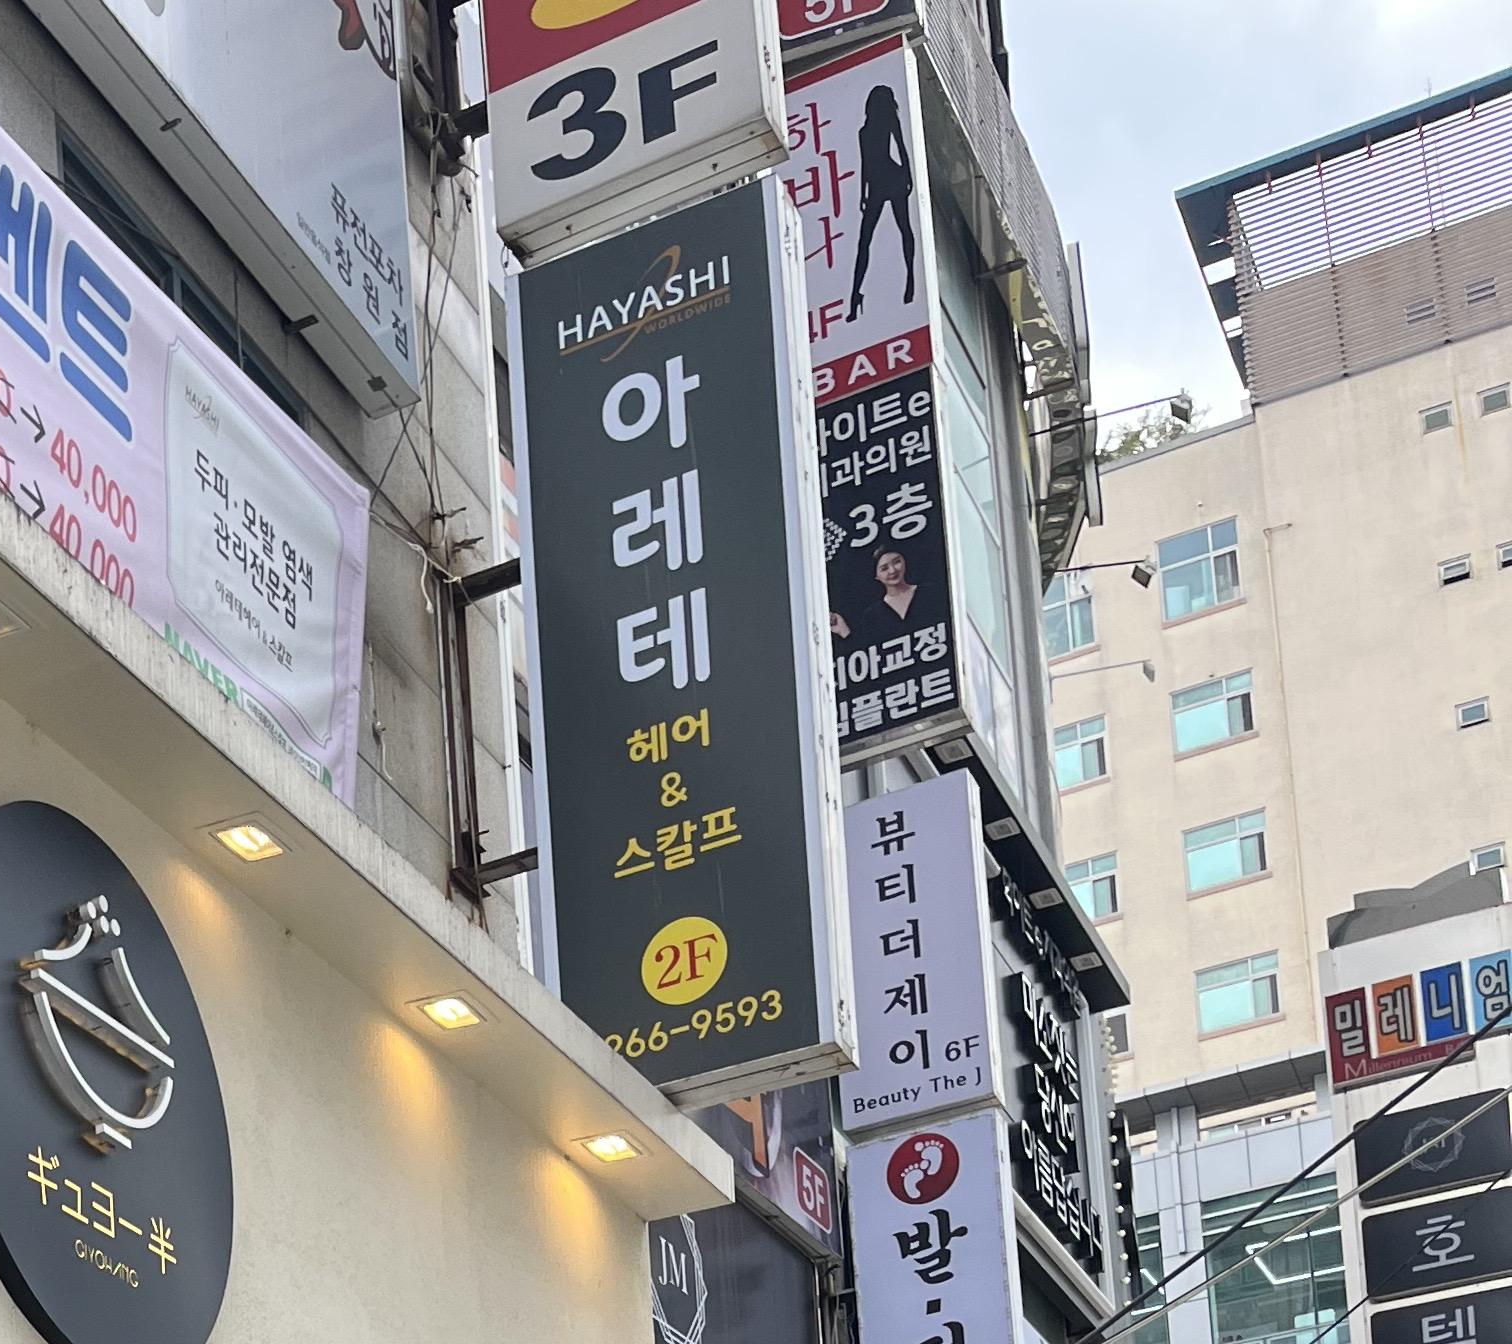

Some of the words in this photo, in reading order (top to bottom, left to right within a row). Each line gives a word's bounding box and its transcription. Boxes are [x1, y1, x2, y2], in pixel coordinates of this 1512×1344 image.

[526, 40, 720, 182] 3F
[558, 255, 731, 351] HAYASHI
[816, 338, 916, 396] BAR
[50, 428, 137, 544] 40,000
[849, 483, 933, 549] 3층
[601, 355, 711, 690] 아레테
[213, 512, 297, 630] 관리전문점
[283, 540, 313, 602] 염색
[626, 708, 711, 764] 헤어
[660, 772, 688, 807] &
[613, 806, 742, 879] 스칼프
[654, 932, 719, 991] 2F
[1333, 959, 1510, 1058] 밀레니엄
[944, 1035, 981, 1064] 6F
[852, 1085, 921, 1115] Beauty
[930, 1074, 967, 1095] The
[974, 1067, 983, 1086] J
[802, 1165, 826, 1219] 5F
[658, 1235, 689, 1296] JM
